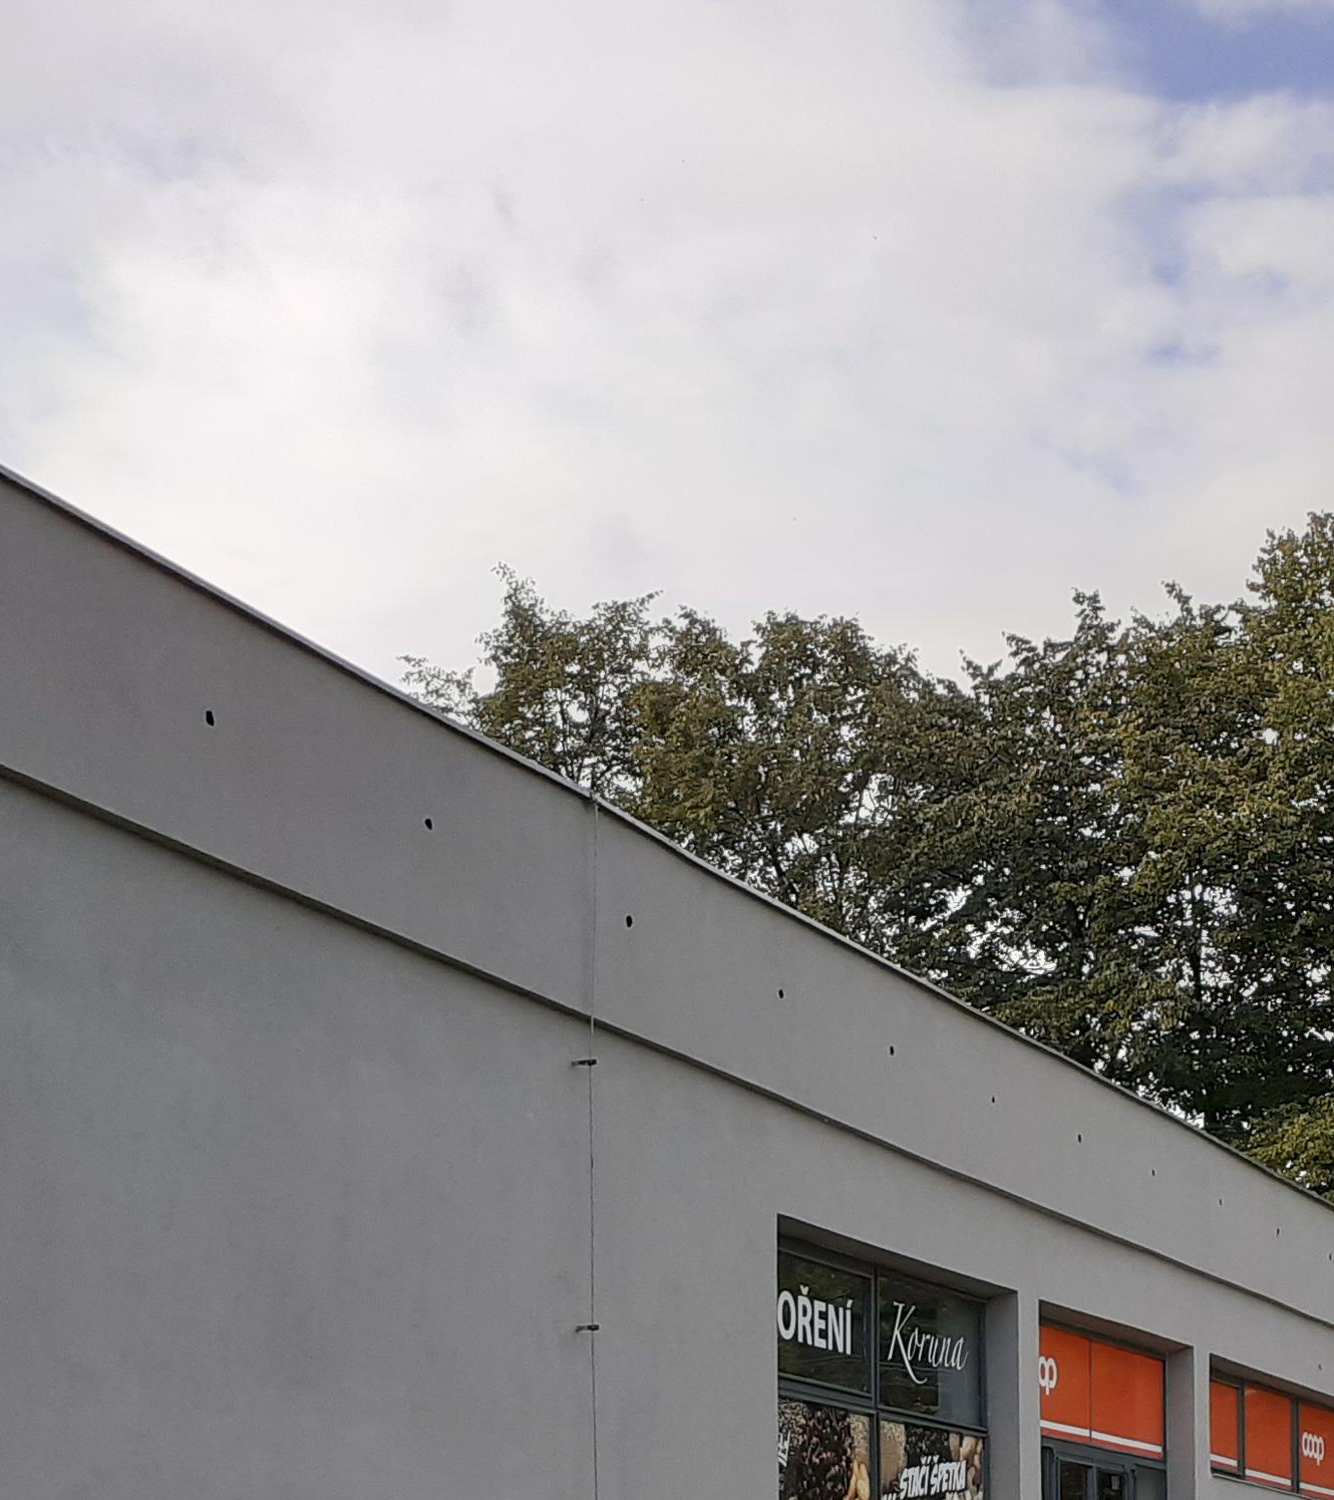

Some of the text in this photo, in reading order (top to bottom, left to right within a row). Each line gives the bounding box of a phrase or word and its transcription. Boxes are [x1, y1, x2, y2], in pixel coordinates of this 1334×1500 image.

[887, 1301, 968, 1384] Koruna
[1302, 1432, 1324, 1466] coop
[930, 1455, 966, 1496] ŠPETKA
